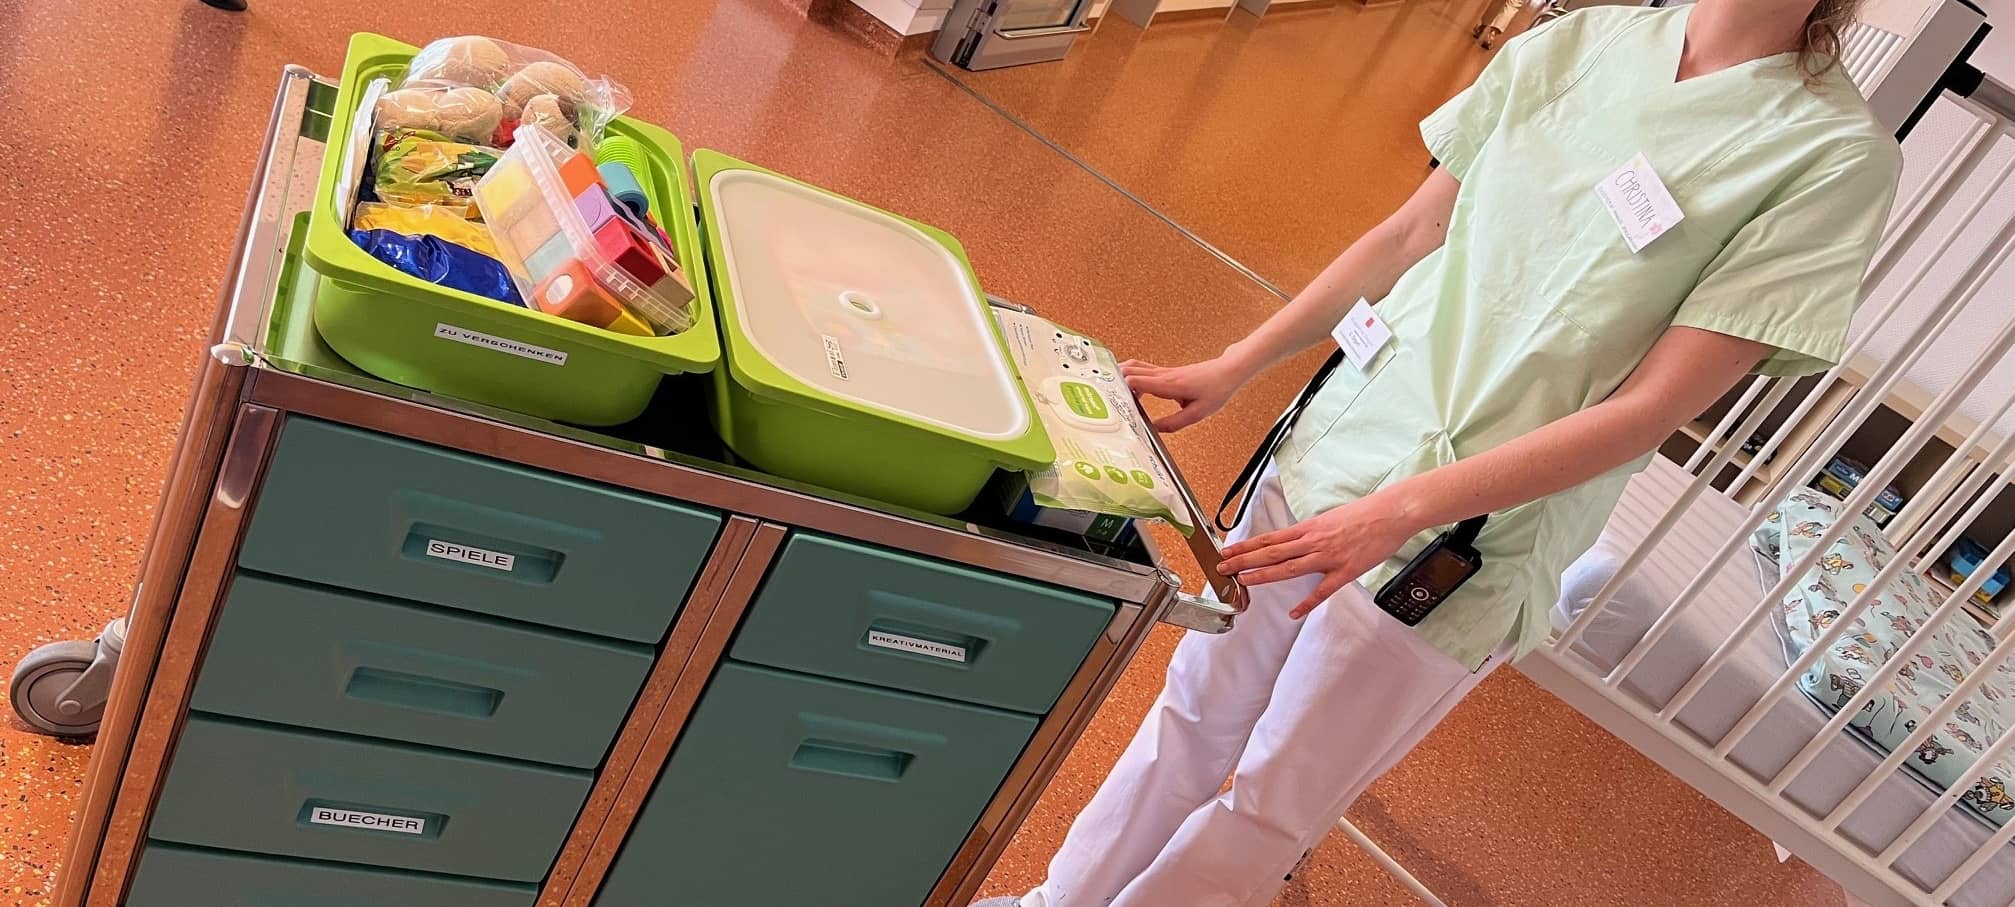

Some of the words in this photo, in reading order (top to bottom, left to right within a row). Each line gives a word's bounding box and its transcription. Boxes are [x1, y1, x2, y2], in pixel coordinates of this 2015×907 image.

[1615, 170, 1656, 229] CHRISTINA
[439, 328, 457, 336] ZU
[462, 333, 563, 361] VERSCHENKEN
[1101, 518, 1114, 529] M
[430, 543, 509, 566] SPIELE
[872, 635, 964, 657] KREATIVMATERIAL
[318, 811, 419, 830] BUECHER
